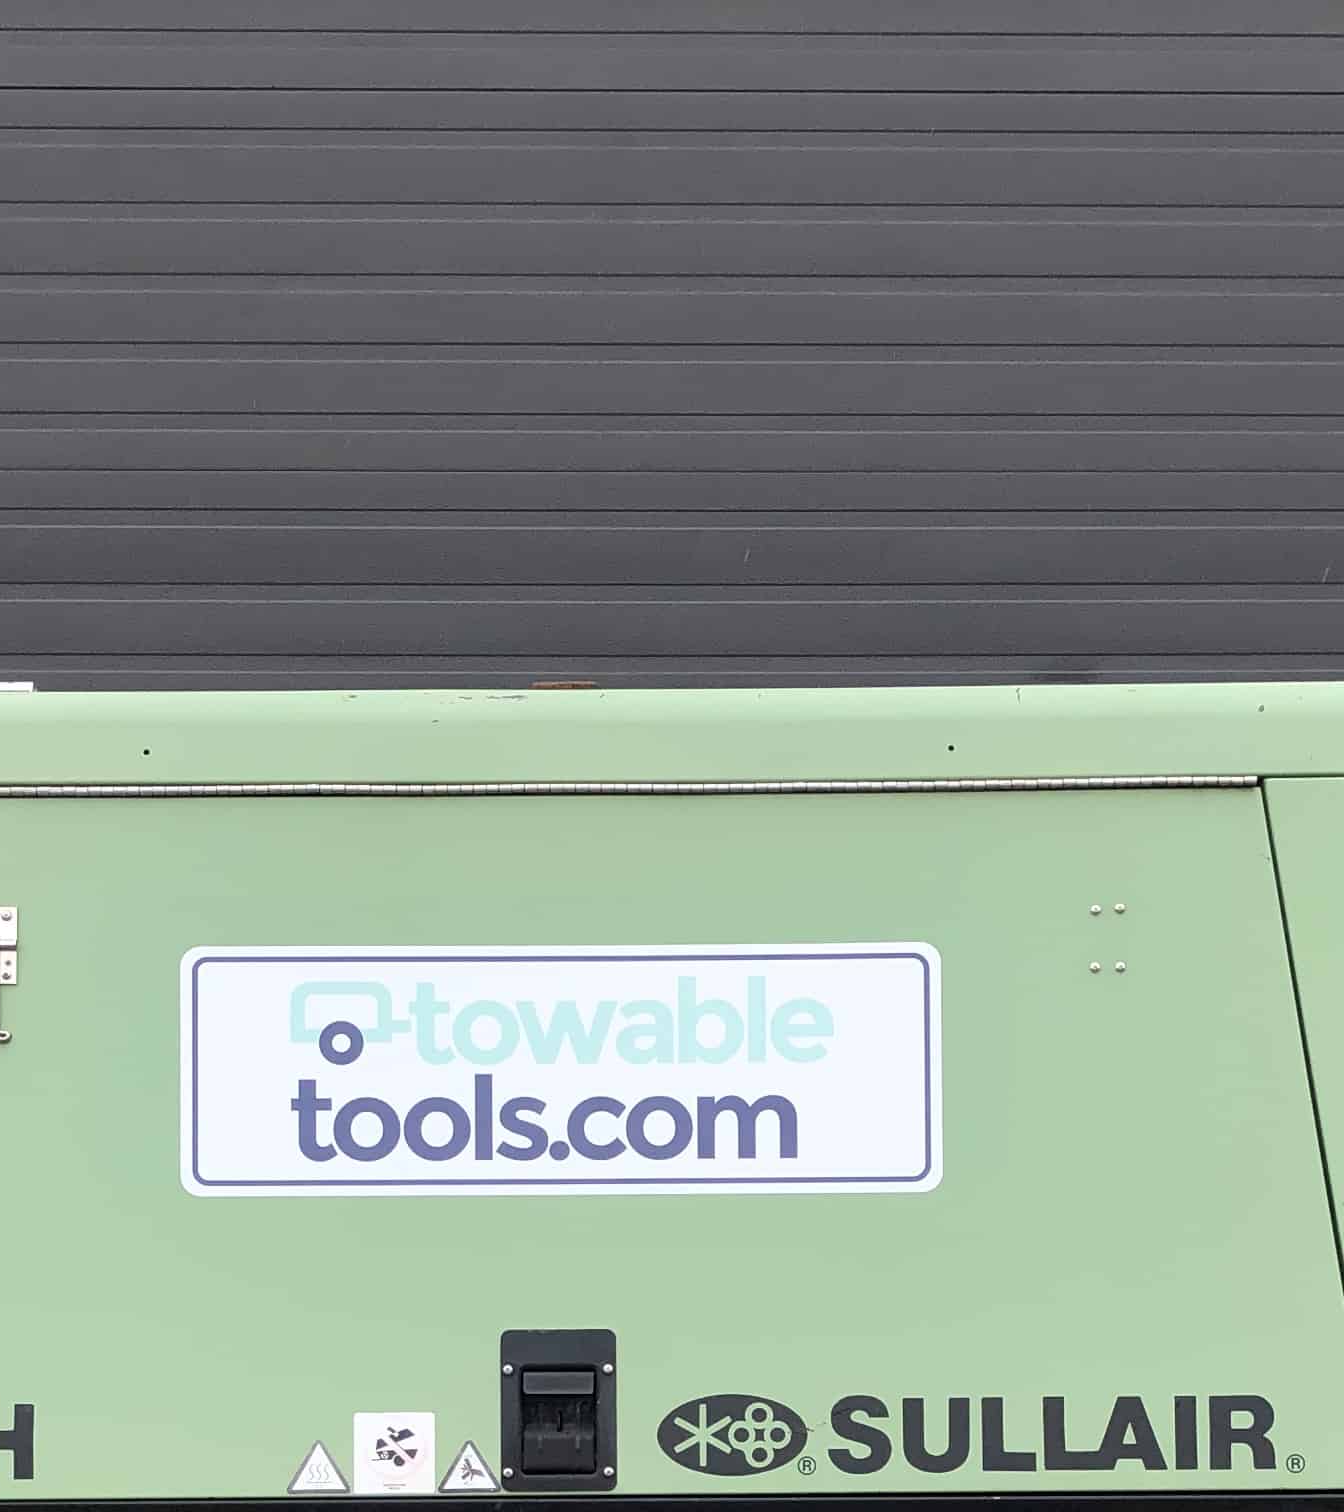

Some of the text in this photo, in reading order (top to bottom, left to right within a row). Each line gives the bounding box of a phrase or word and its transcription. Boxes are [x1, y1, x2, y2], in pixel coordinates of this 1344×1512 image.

[409, 975, 835, 1065] towable
[291, 1073, 799, 1163] tools.com
[827, 1394, 1277, 1475] SULLAIR
